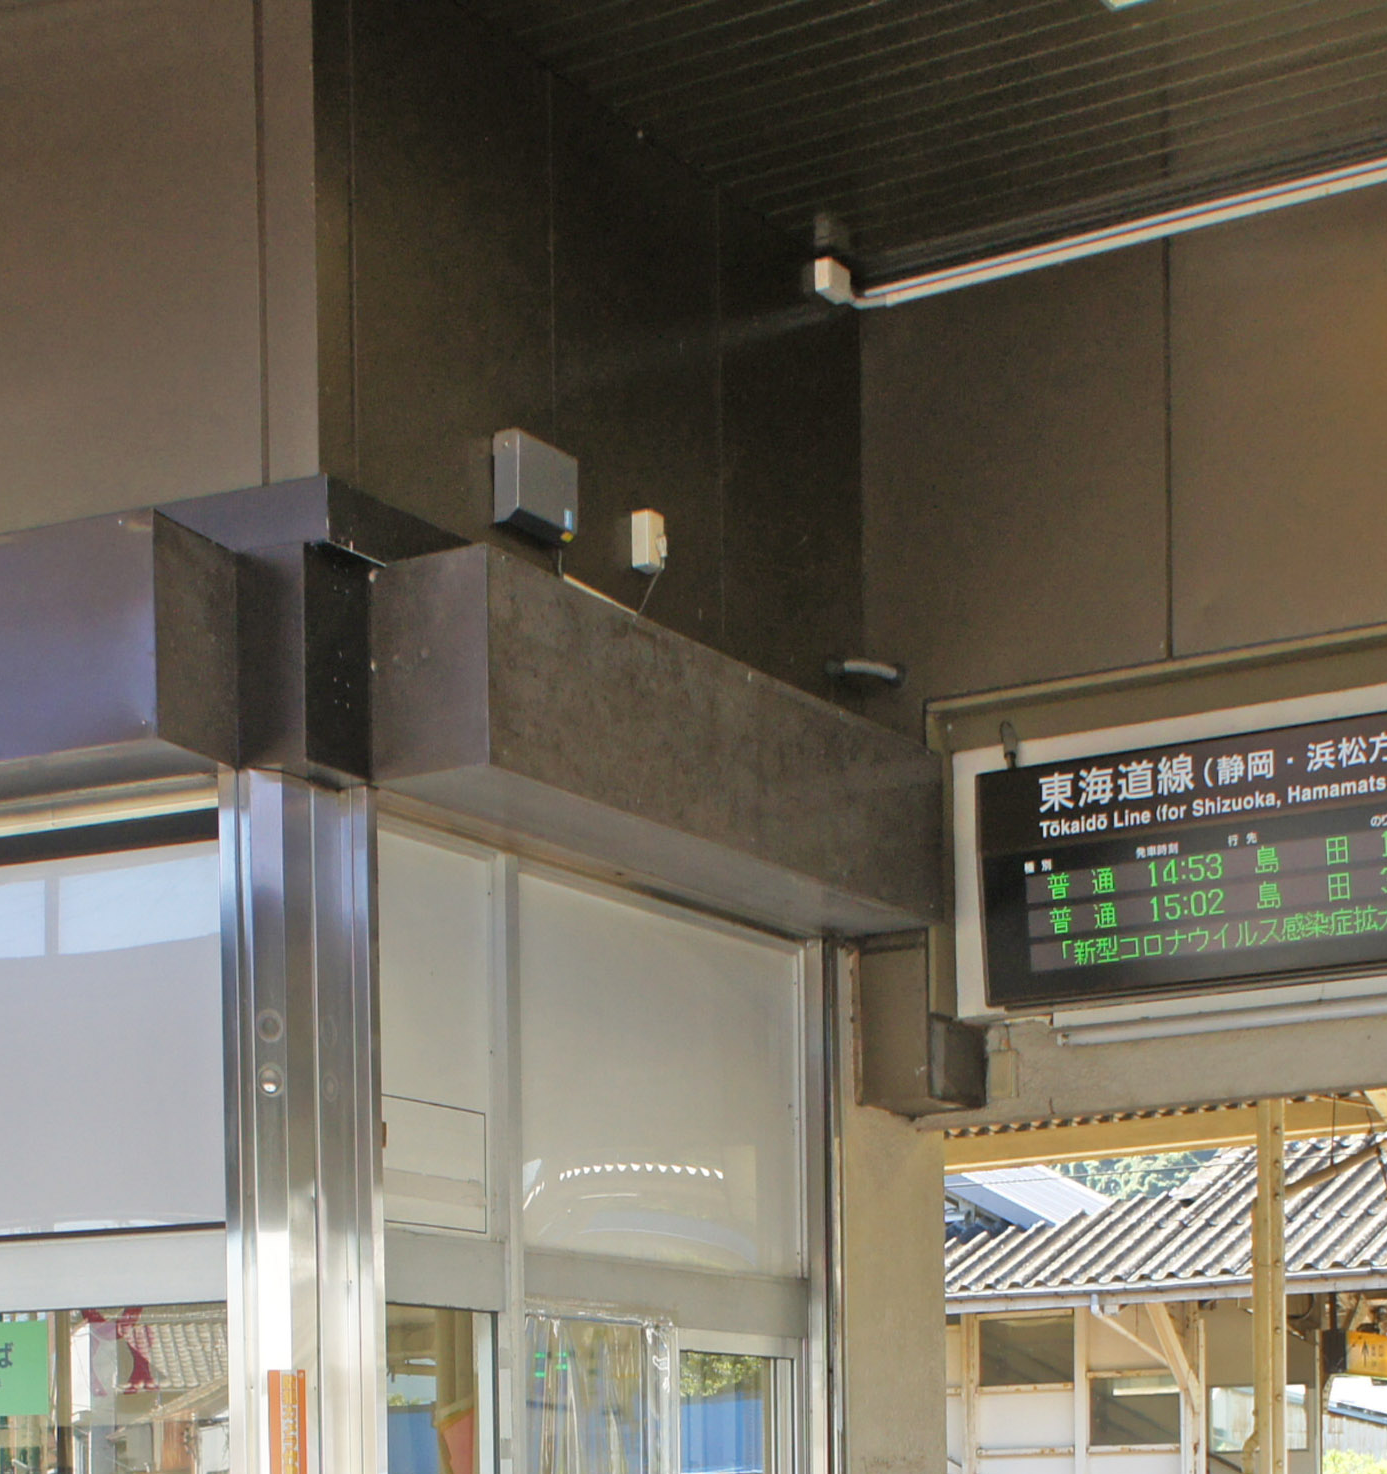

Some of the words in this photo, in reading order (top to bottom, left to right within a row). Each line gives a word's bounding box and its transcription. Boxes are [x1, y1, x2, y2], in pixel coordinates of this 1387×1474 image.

[1039, 812, 1109, 840] Tōkaidō
[1113, 804, 1152, 829] Line
[1155, 799, 1190, 827] (for
[1192, 788, 1283, 821] Shizuoka,
[1148, 853, 1224, 887] 14:53
[1149, 889, 1226, 924] 15:02
